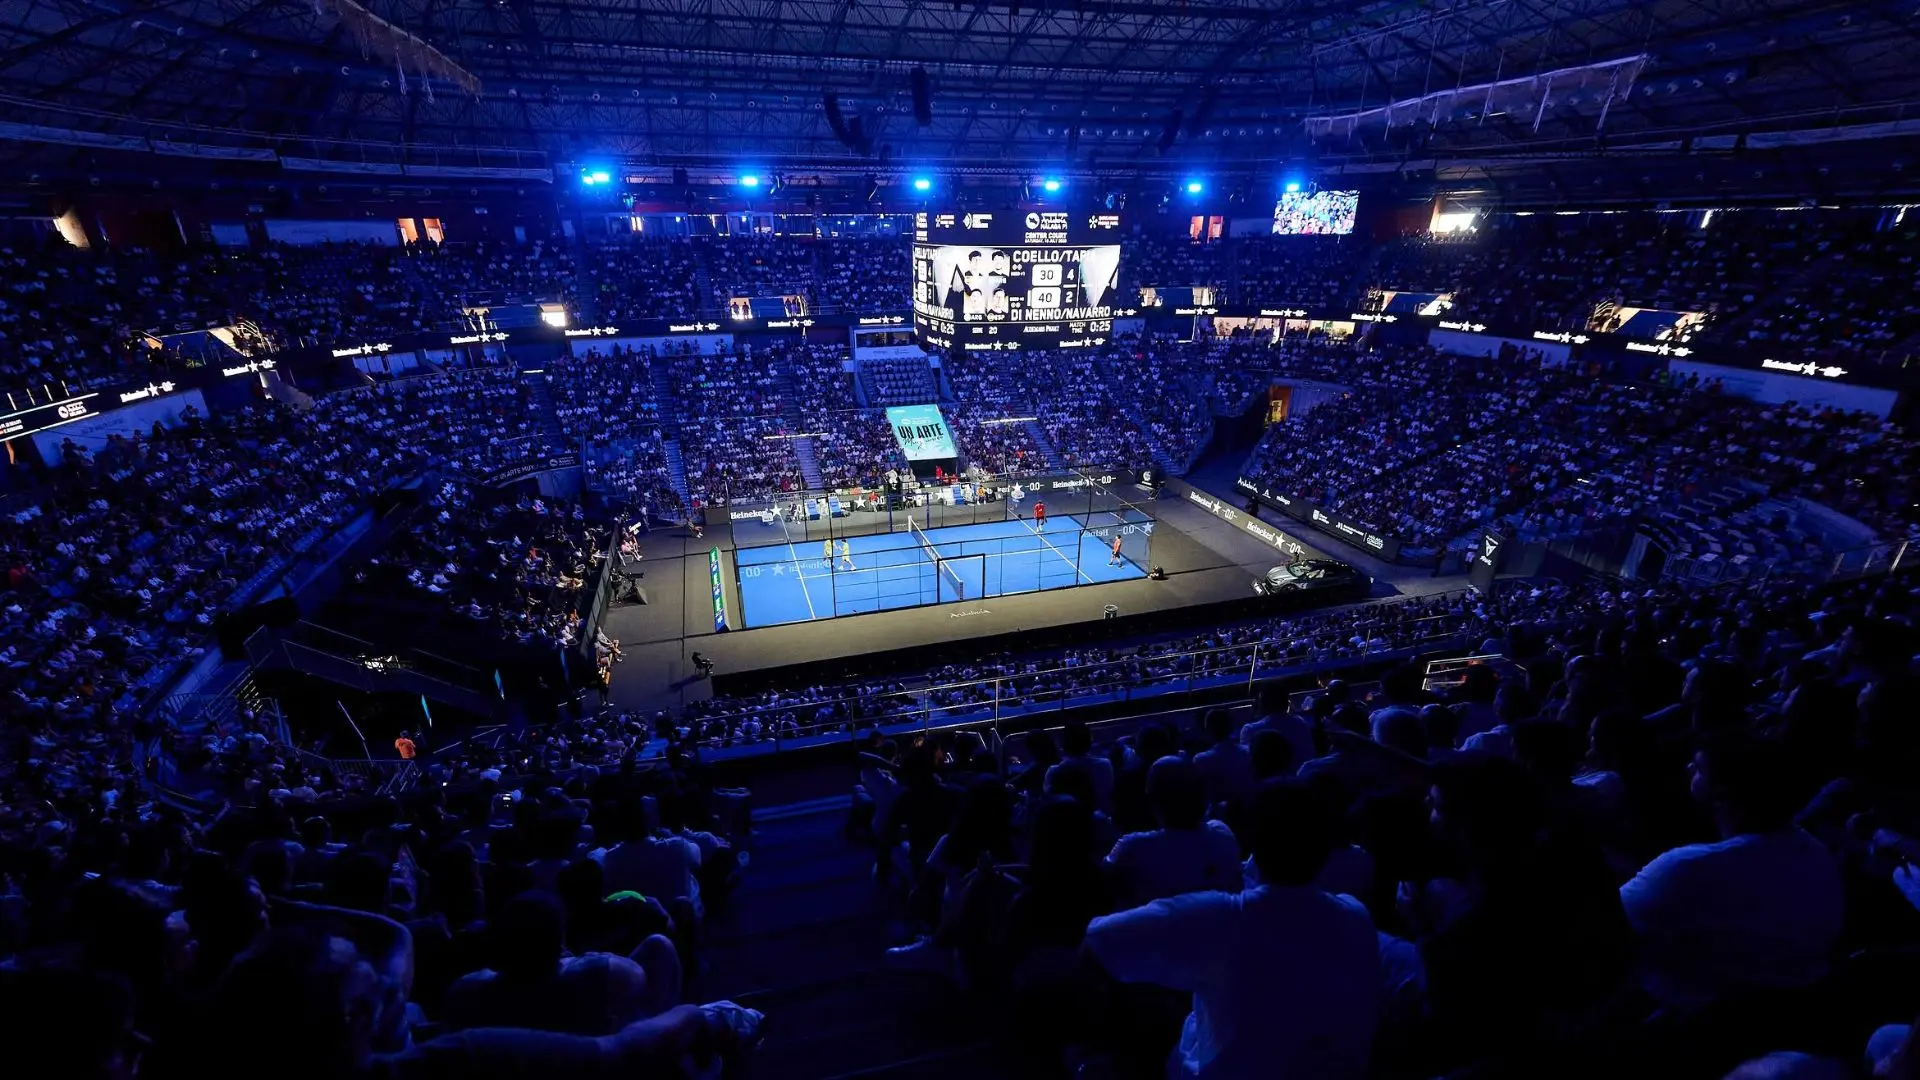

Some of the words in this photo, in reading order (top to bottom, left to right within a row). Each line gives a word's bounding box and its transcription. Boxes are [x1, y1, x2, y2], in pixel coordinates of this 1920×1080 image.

[1040, 270, 1054, 280] 30
[1067, 269, 1074, 280] 4
[1038, 292, 1052, 302] 40
[1066, 291, 1073, 303] 2
[1011, 309, 1022, 321] DI
[1025, 306, 1110, 320] NENNO/NAVARRO
[1090, 321, 1110, 332] 0:25
[898, 425, 914, 439] UN
[916, 423, 943, 438] ARTE
[1247, 521, 1275, 542] Heineken
